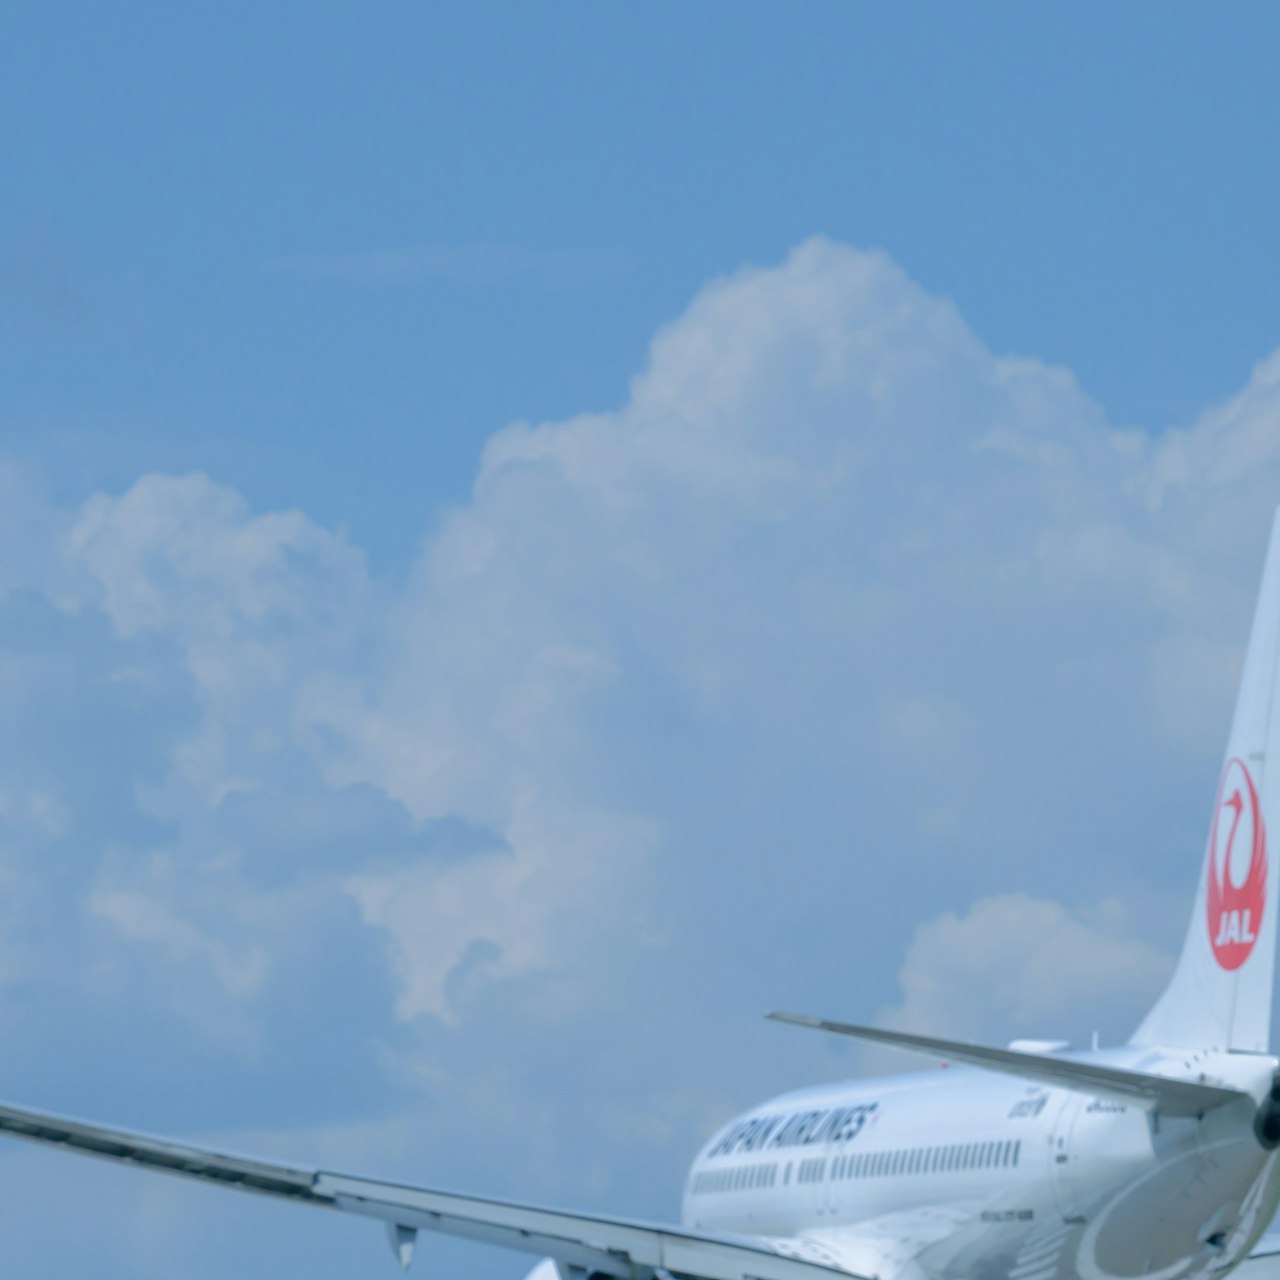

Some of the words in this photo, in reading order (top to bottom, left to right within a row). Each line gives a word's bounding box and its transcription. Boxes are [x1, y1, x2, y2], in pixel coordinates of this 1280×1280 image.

[1216, 909, 1254, 946] JAL
[708, 1115, 786, 1159] JAPAN
[767, 1102, 878, 1146] AIRLINES
